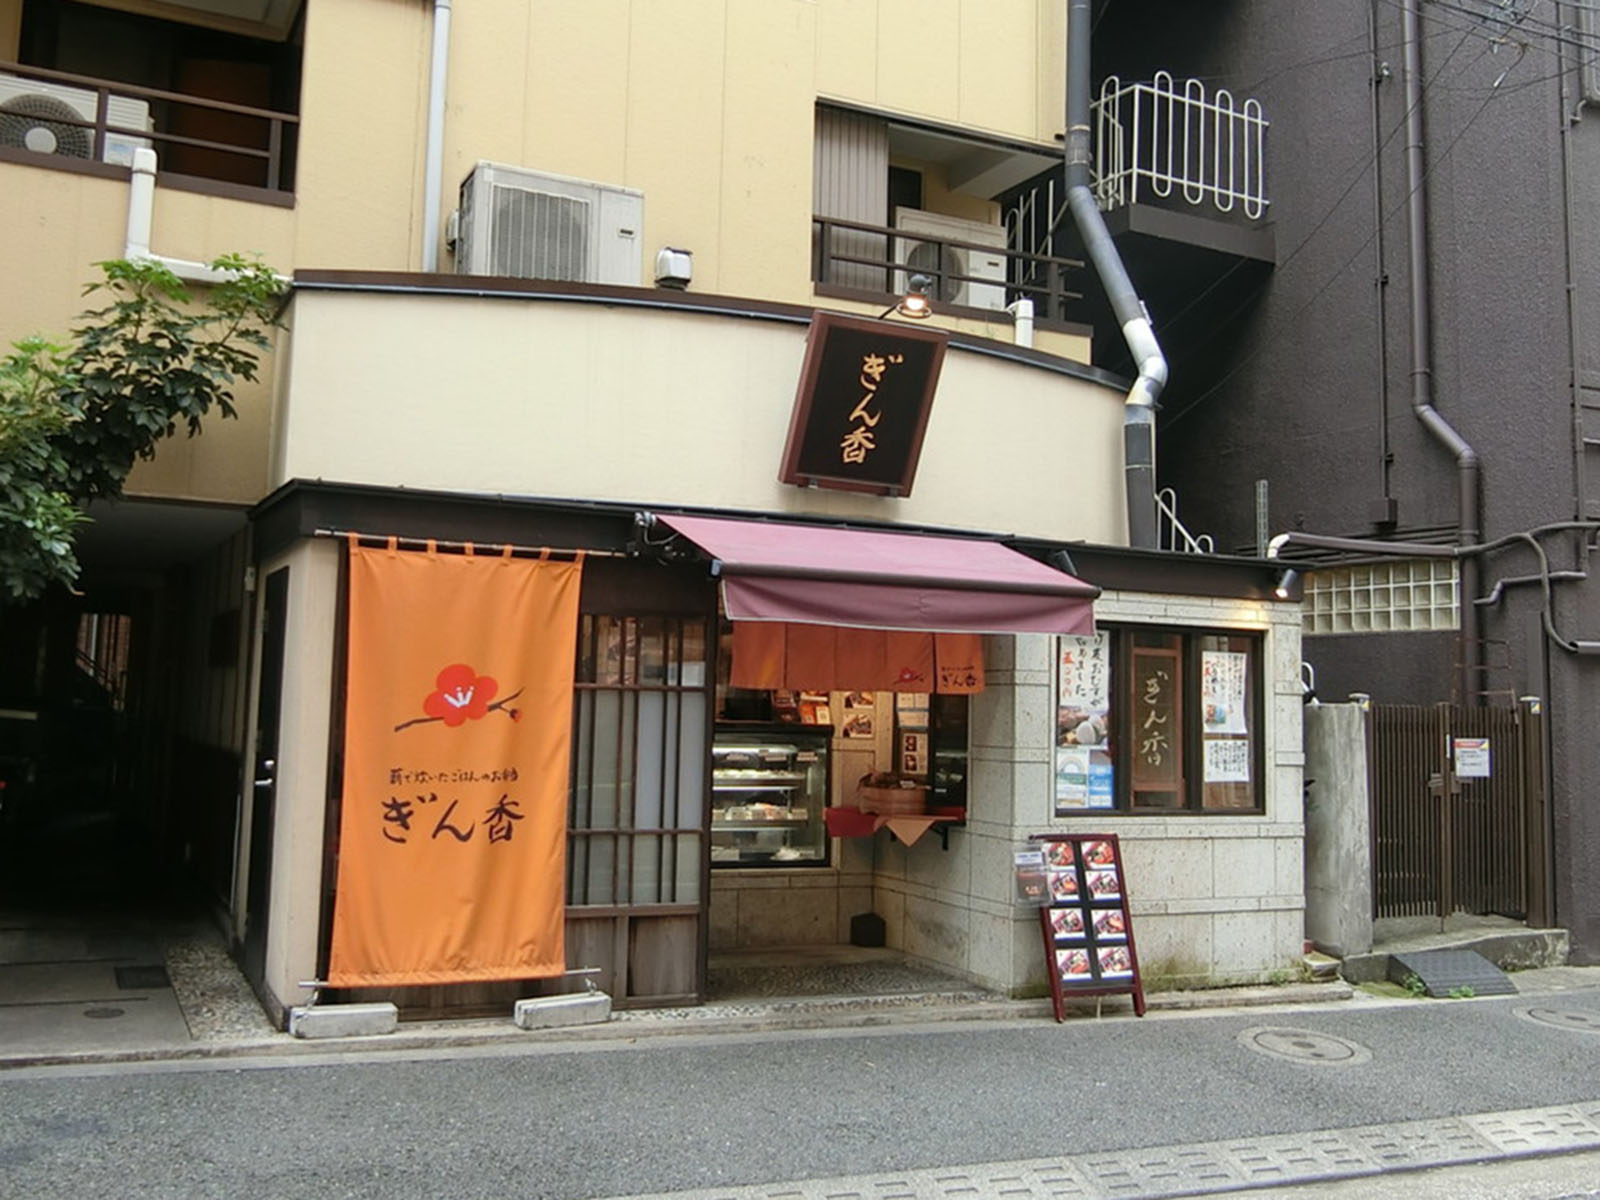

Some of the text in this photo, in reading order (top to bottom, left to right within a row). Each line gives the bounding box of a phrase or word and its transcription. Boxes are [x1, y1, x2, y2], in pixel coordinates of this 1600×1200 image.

[840, 353, 904, 464] ぎん香
[381, 793, 525, 844] ぎん香
